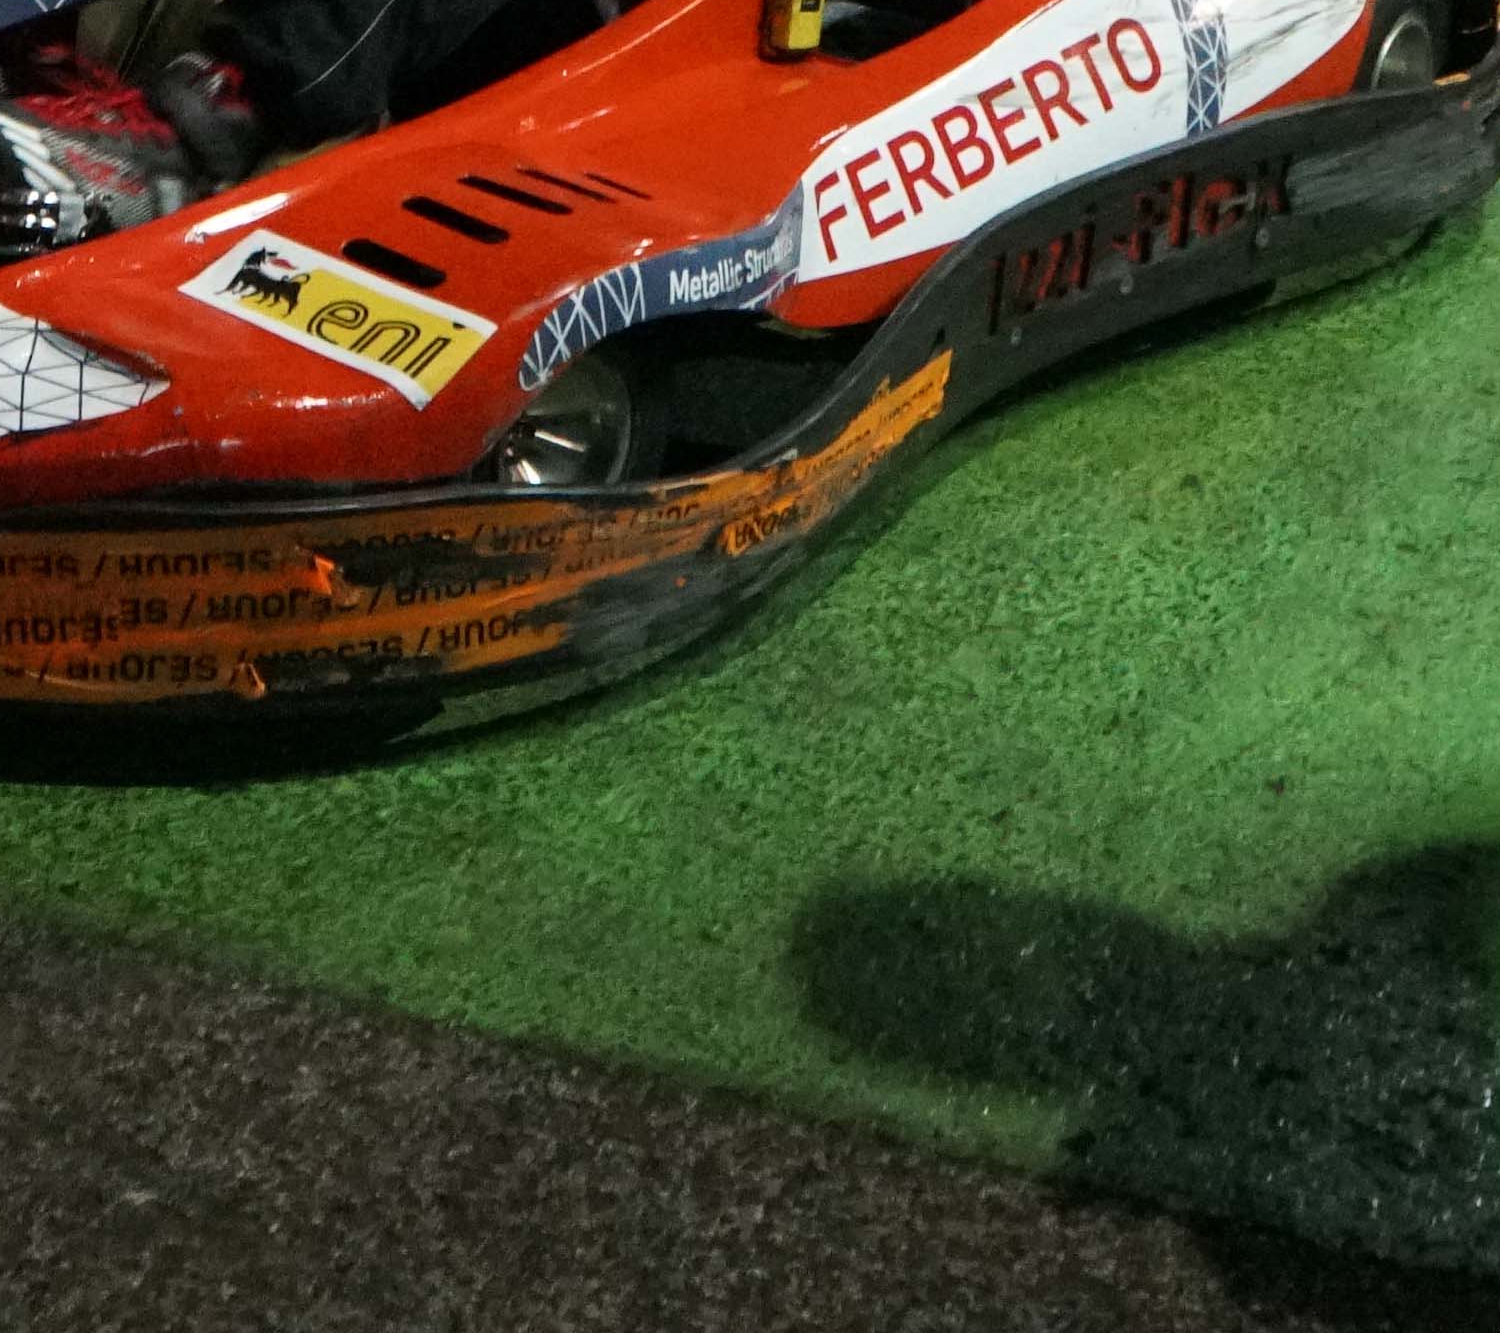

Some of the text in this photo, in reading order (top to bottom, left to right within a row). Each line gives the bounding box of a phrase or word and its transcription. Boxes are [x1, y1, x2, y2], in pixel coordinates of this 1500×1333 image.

[813, 17, 1162, 264] FERBERTO
[668, 257, 743, 306] Metallic
[305, 293, 456, 383] eni
